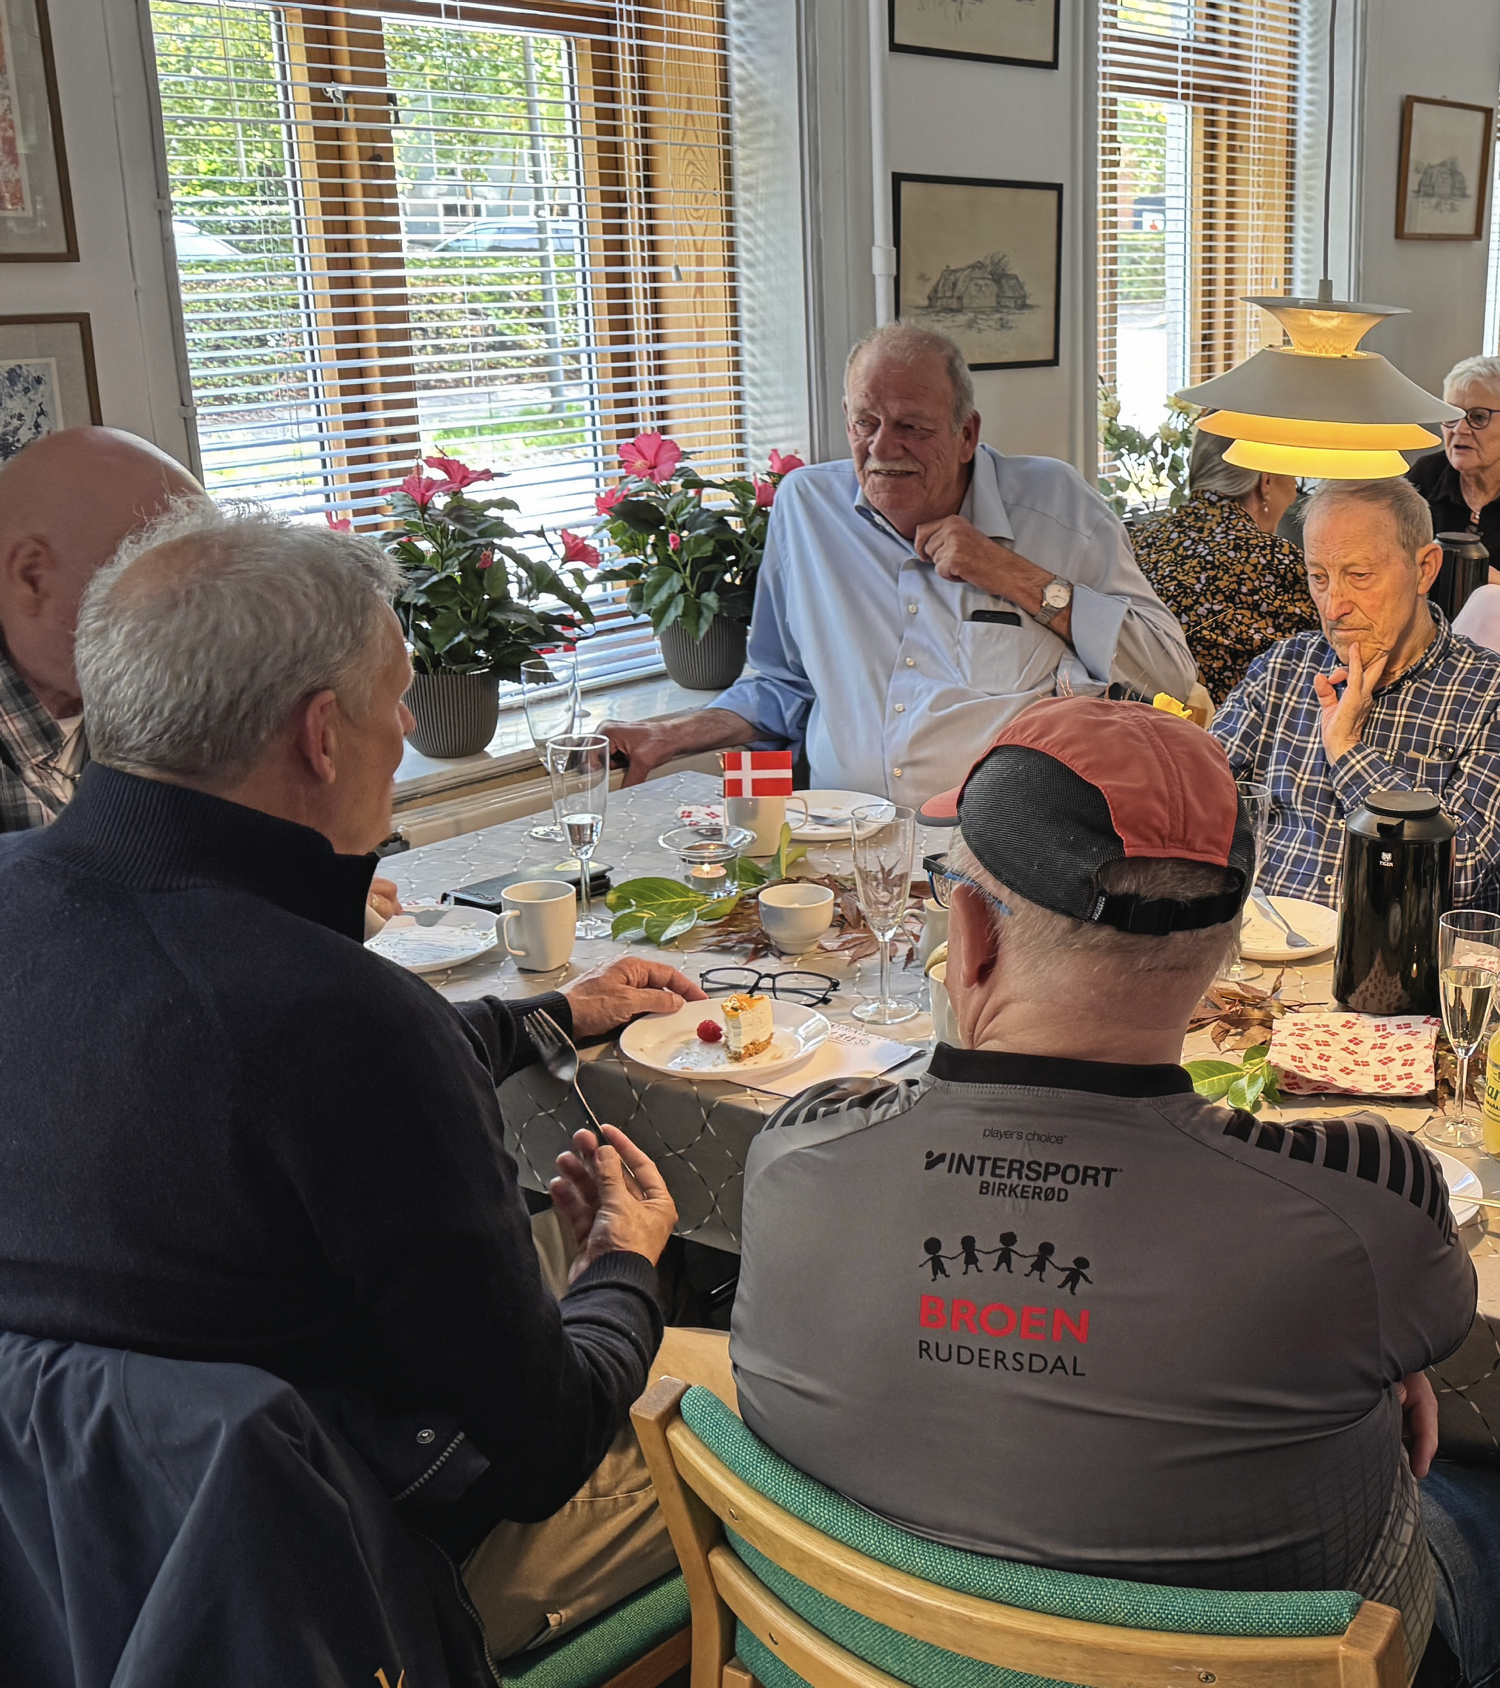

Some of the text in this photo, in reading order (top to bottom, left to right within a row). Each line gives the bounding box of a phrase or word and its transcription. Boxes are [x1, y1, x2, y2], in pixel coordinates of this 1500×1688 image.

[947, 1152, 1118, 1188] INTERSPORT
[978, 1180, 1069, 1202] BIRKERØD
[919, 1294, 1091, 1344] BROEN
[918, 1339, 1087, 1377] RUDERSDAL
